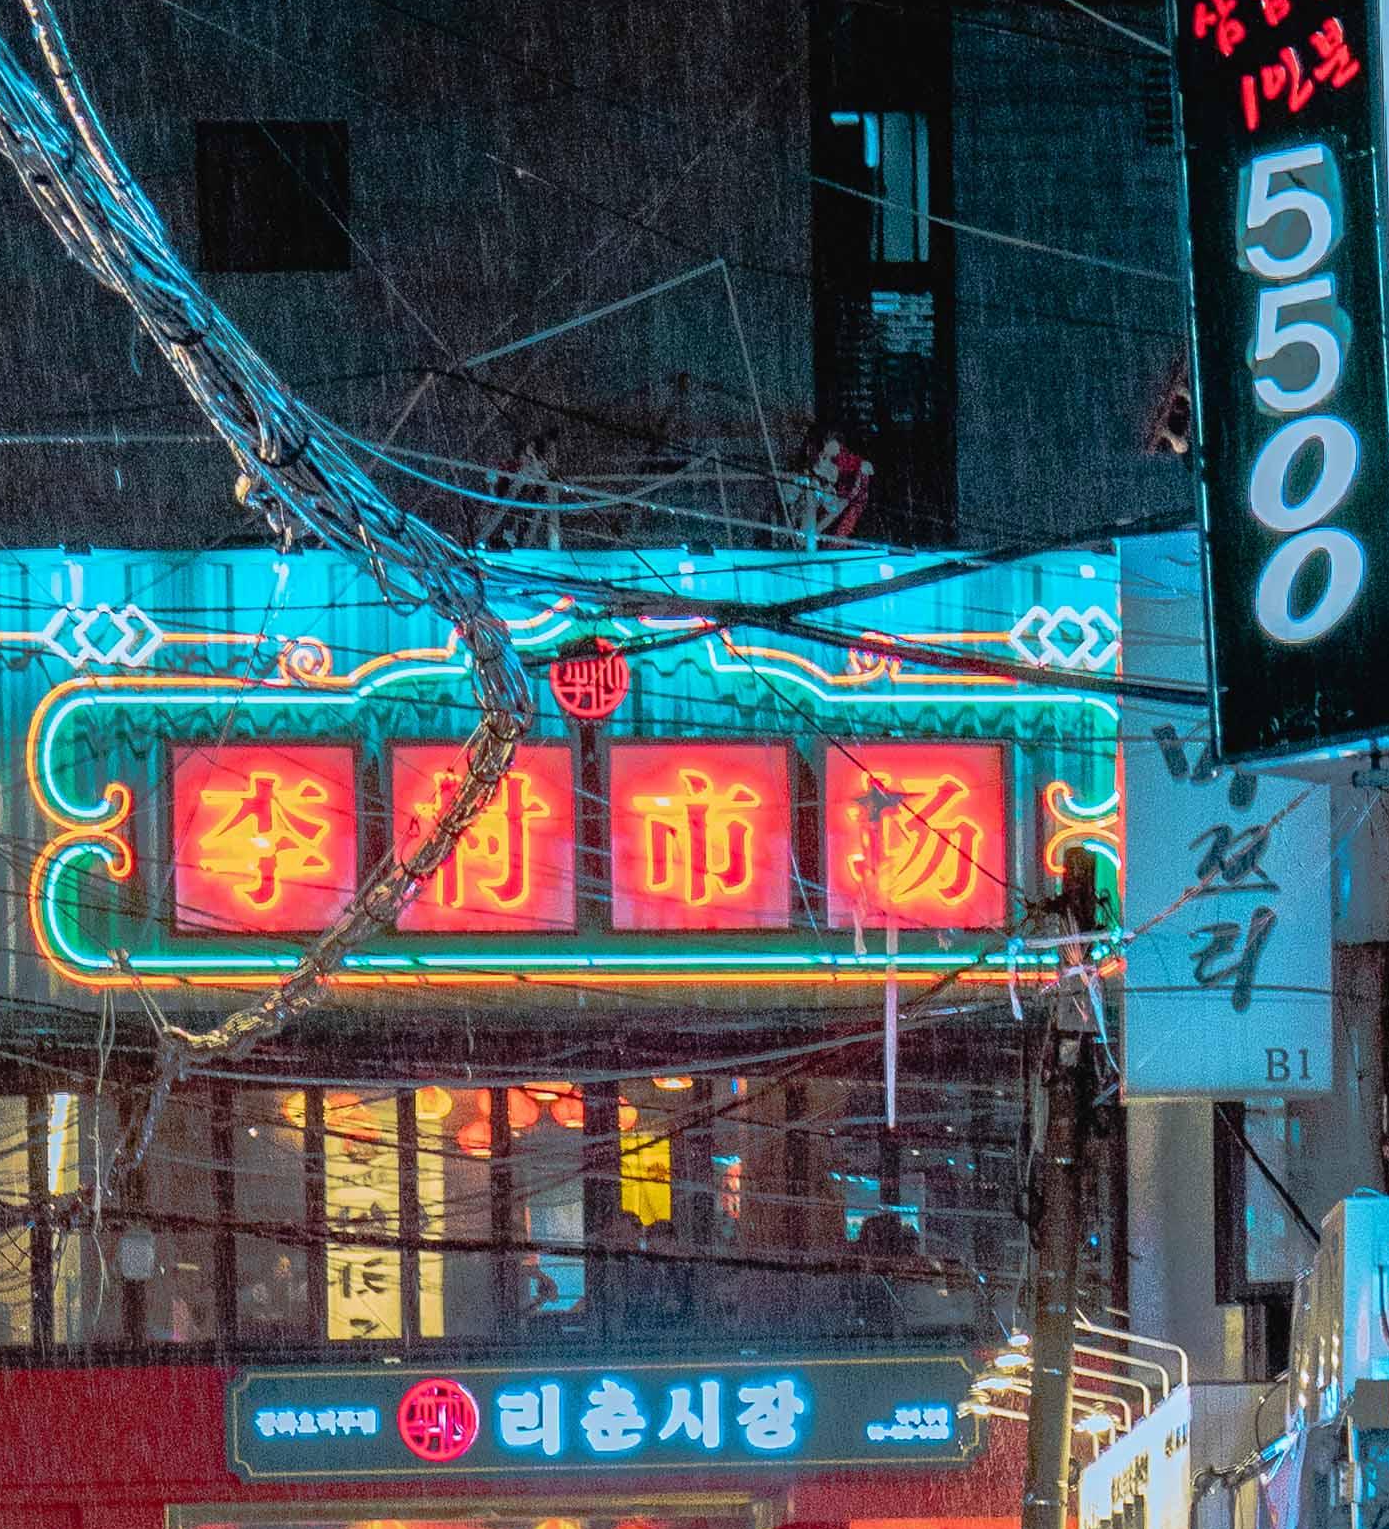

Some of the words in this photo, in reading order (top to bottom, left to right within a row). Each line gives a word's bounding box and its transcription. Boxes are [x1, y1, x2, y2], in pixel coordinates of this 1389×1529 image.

[1241, 16, 1360, 132] 1인분
[1245, 144, 1366, 644] 5500
[1265, 1048, 1312, 1082] B1
[498, 1379, 804, 1456] 리춘시장
